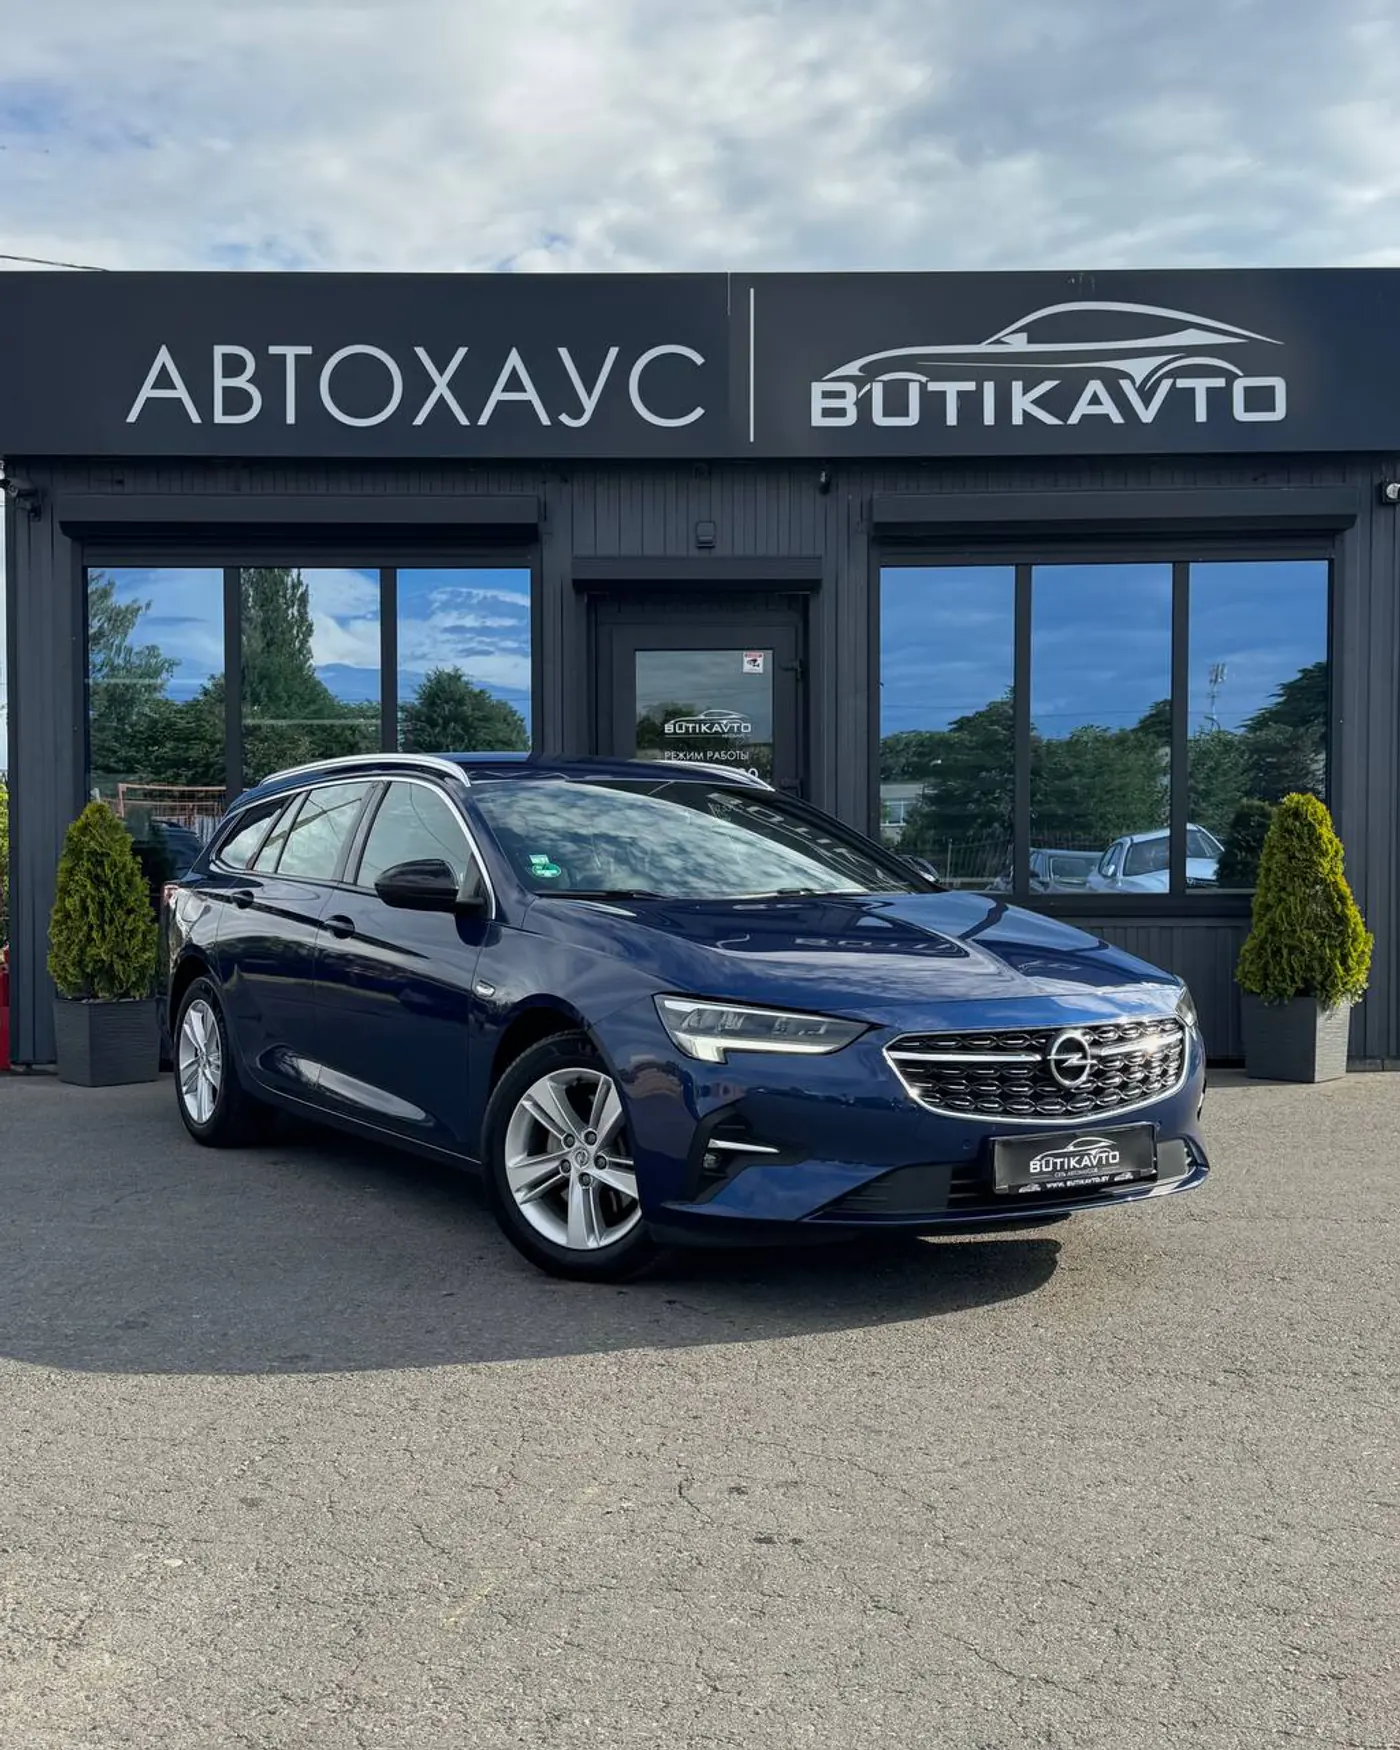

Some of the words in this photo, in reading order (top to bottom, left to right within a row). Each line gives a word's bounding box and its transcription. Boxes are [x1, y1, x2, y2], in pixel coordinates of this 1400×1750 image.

[125, 343, 706, 428] АВТОХАУС
[810, 375, 1287, 427] BUTIKAVTO
[664, 722, 752, 734] BUTIKAVTO
[664, 750, 704, 761] РЕЖИМ
[706, 750, 750, 761] РАБОТЫ
[1029, 1151, 1120, 1173] BUTIKAVTO
